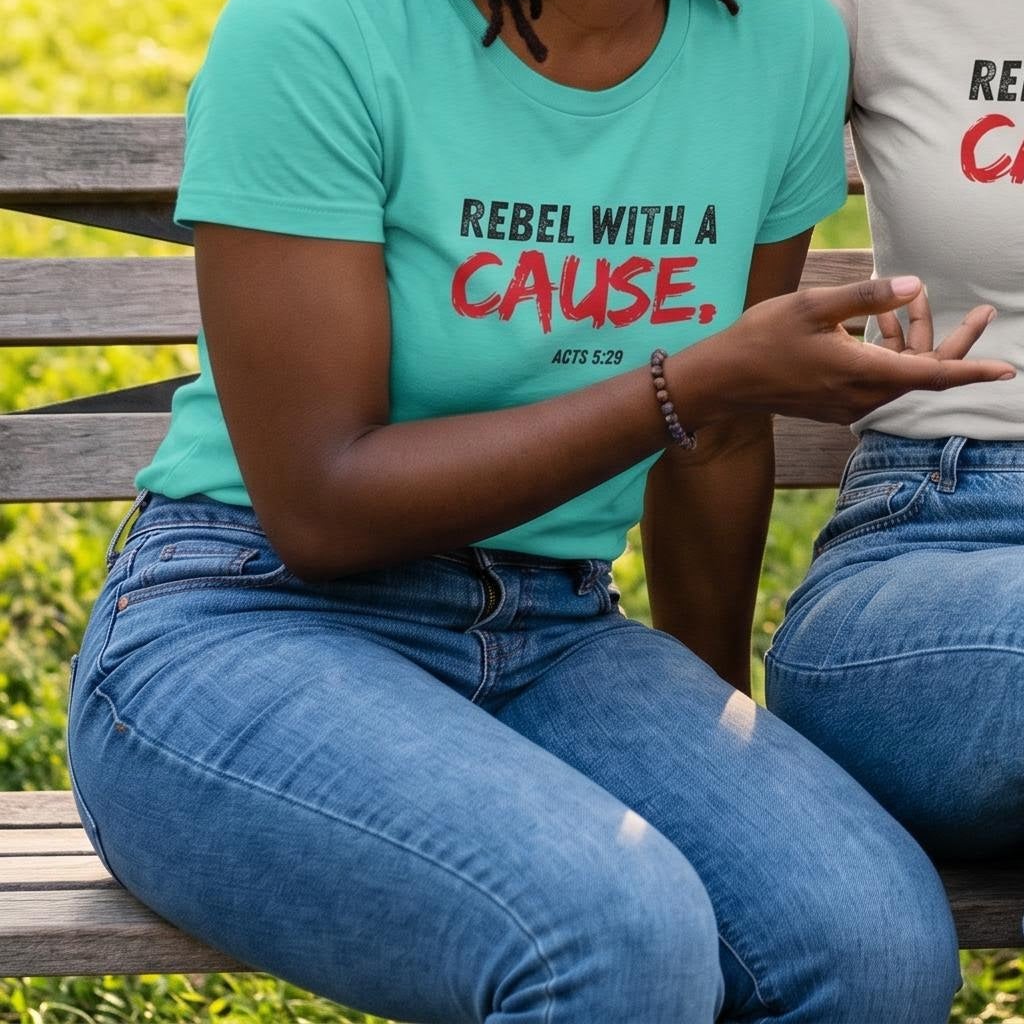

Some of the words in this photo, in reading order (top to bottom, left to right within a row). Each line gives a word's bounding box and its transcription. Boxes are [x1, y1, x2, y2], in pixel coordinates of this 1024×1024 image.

[460, 198, 575, 244] REBEL
[592, 205, 686, 246] WITH
[694, 204, 717, 245] A
[452, 250, 717, 334] CAUSE.
[551, 349, 588, 365] ACTS
[591, 349, 624, 365] 5:29
